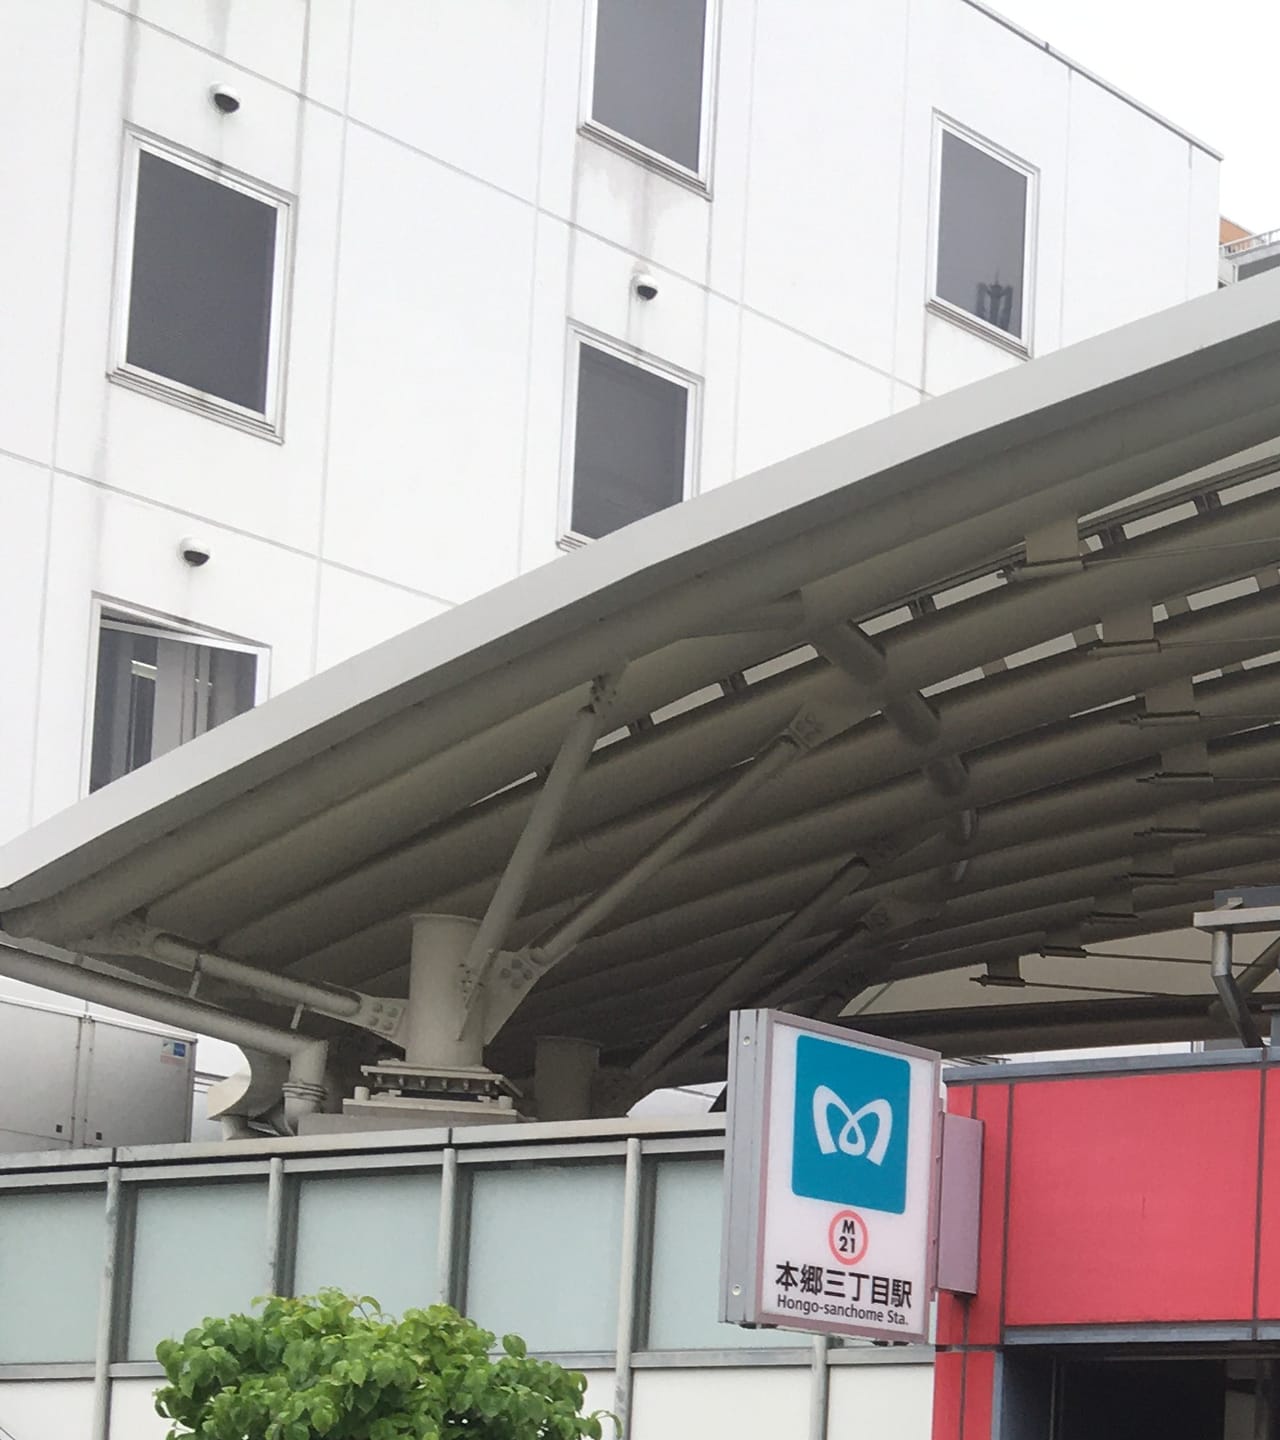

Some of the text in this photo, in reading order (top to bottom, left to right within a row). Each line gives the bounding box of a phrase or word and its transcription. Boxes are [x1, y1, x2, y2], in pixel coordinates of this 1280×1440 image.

[842, 1219, 855, 1235] M
[839, 1237, 856, 1253] 21
[776, 1261, 912, 1309] 本郷三丁目駅
[777, 1294, 909, 1326] Hongo-sanchome Sta.
